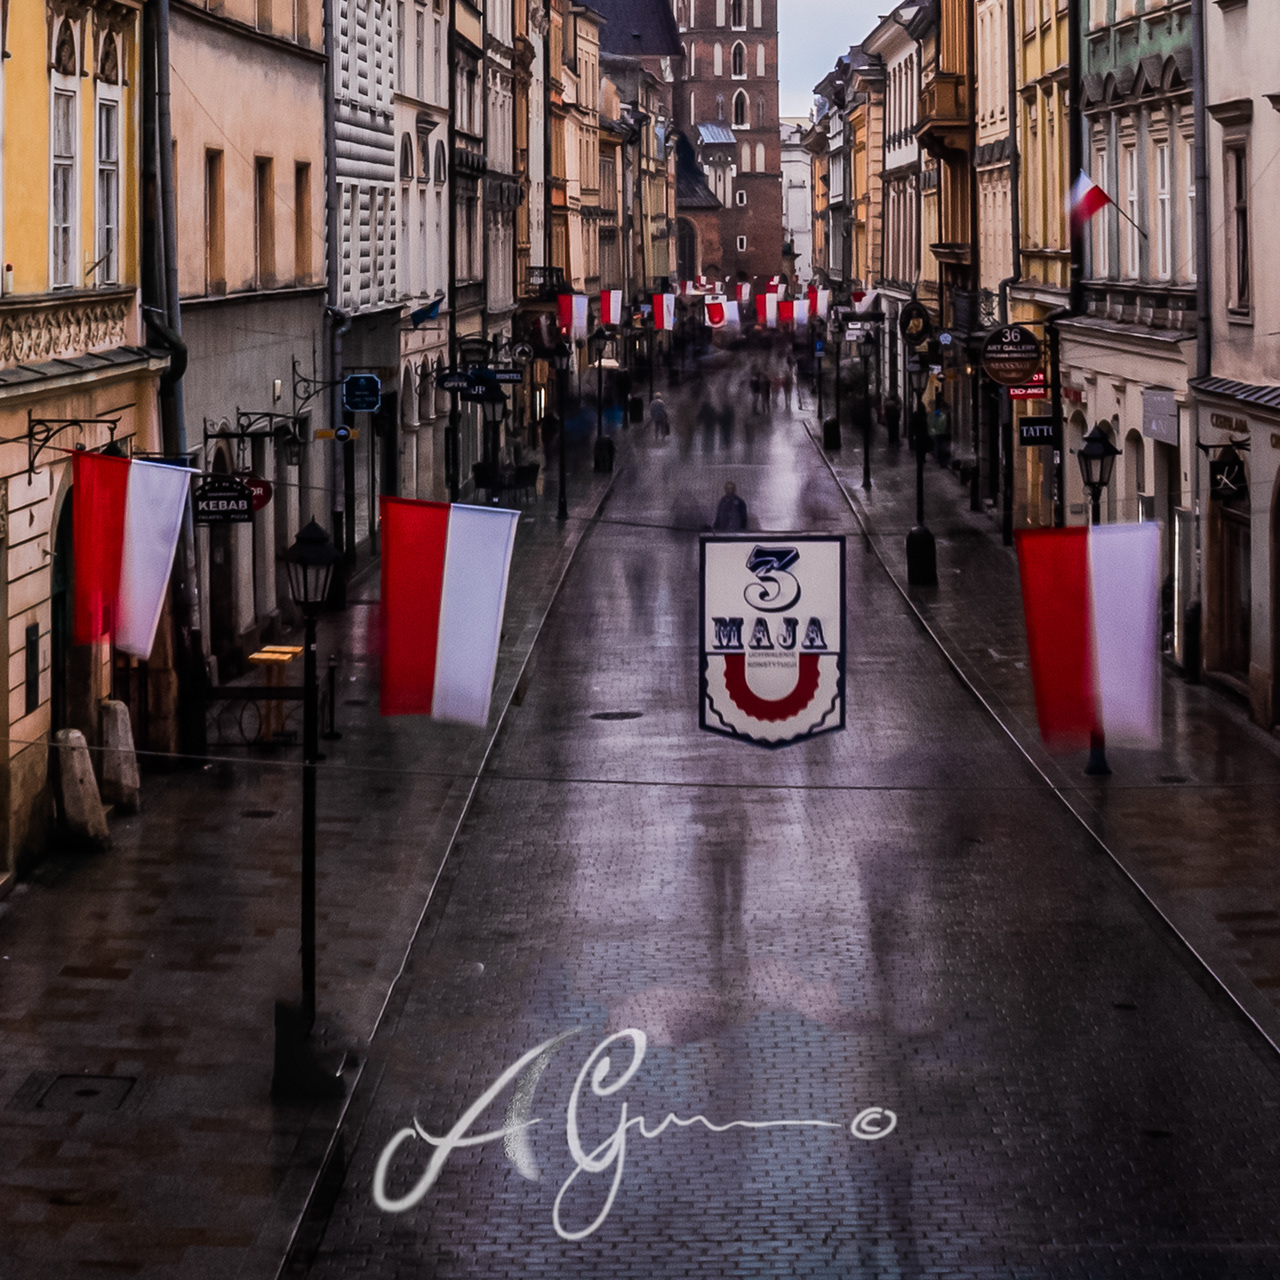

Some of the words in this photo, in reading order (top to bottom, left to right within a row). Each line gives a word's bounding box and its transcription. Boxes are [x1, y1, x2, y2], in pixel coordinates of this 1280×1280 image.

[1001, 328, 1021, 342] 36
[198, 500, 248, 511] KEBAB
[744, 545, 801, 612] 3
[712, 617, 828, 650] MAJA
